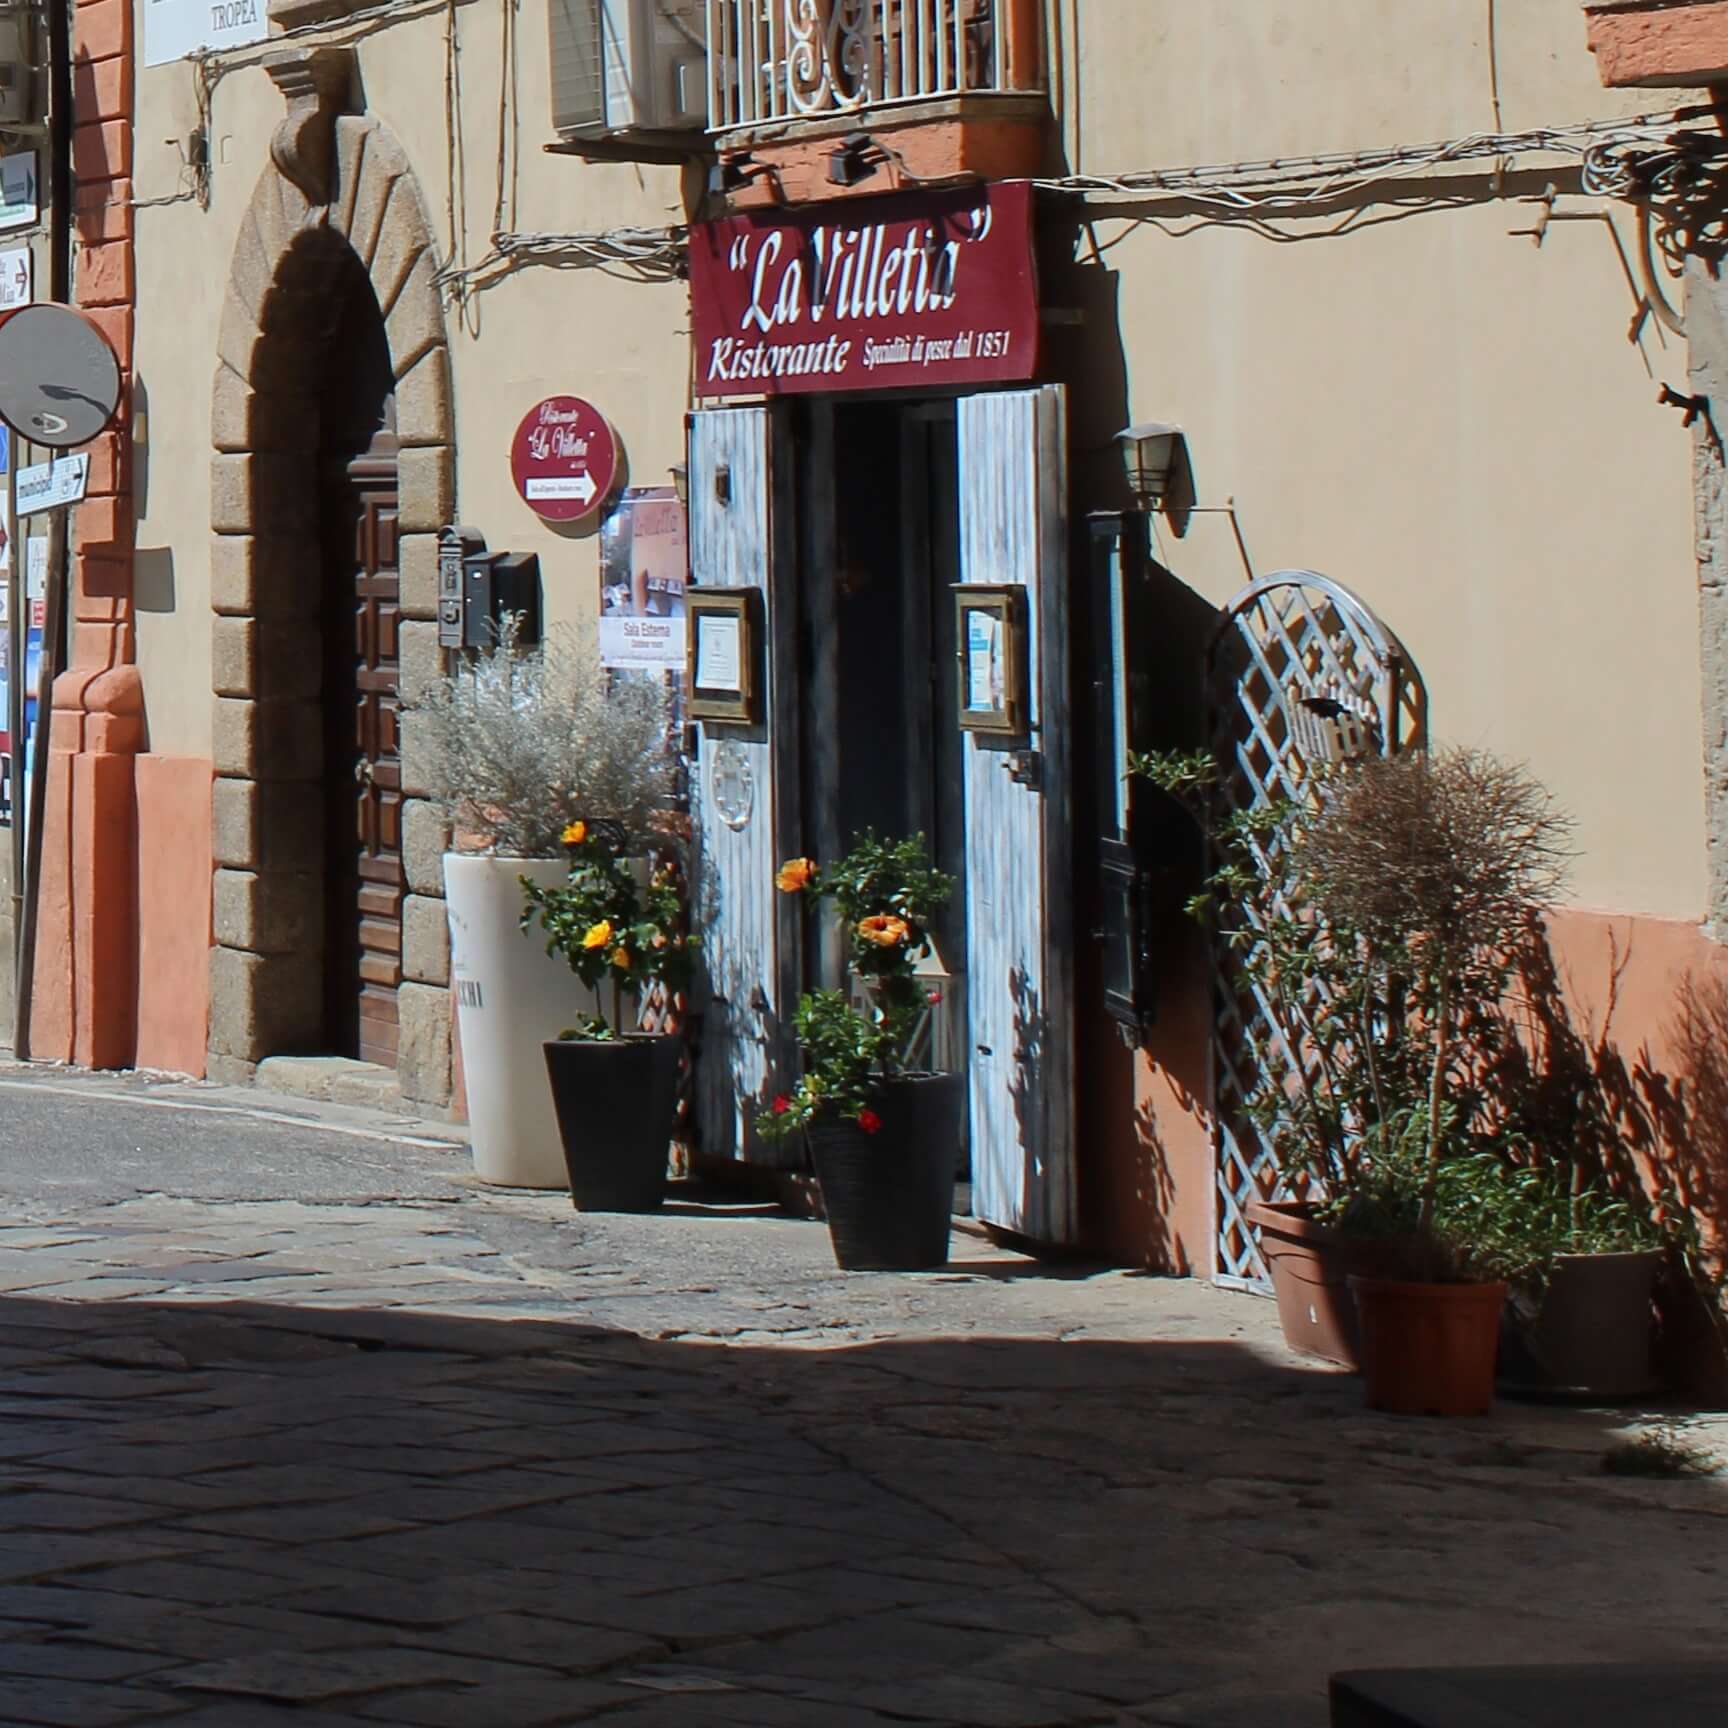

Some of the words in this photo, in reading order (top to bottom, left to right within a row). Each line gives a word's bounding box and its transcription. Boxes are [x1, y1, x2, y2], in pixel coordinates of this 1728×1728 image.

[211, 0, 258, 31] TROPEA
[708, 333, 852, 382] Ristorante
[911, 335, 925, 362] di
[923, 339, 953, 367] pesce
[952, 330, 974, 359] dal
[975, 330, 1011, 357] 1851
